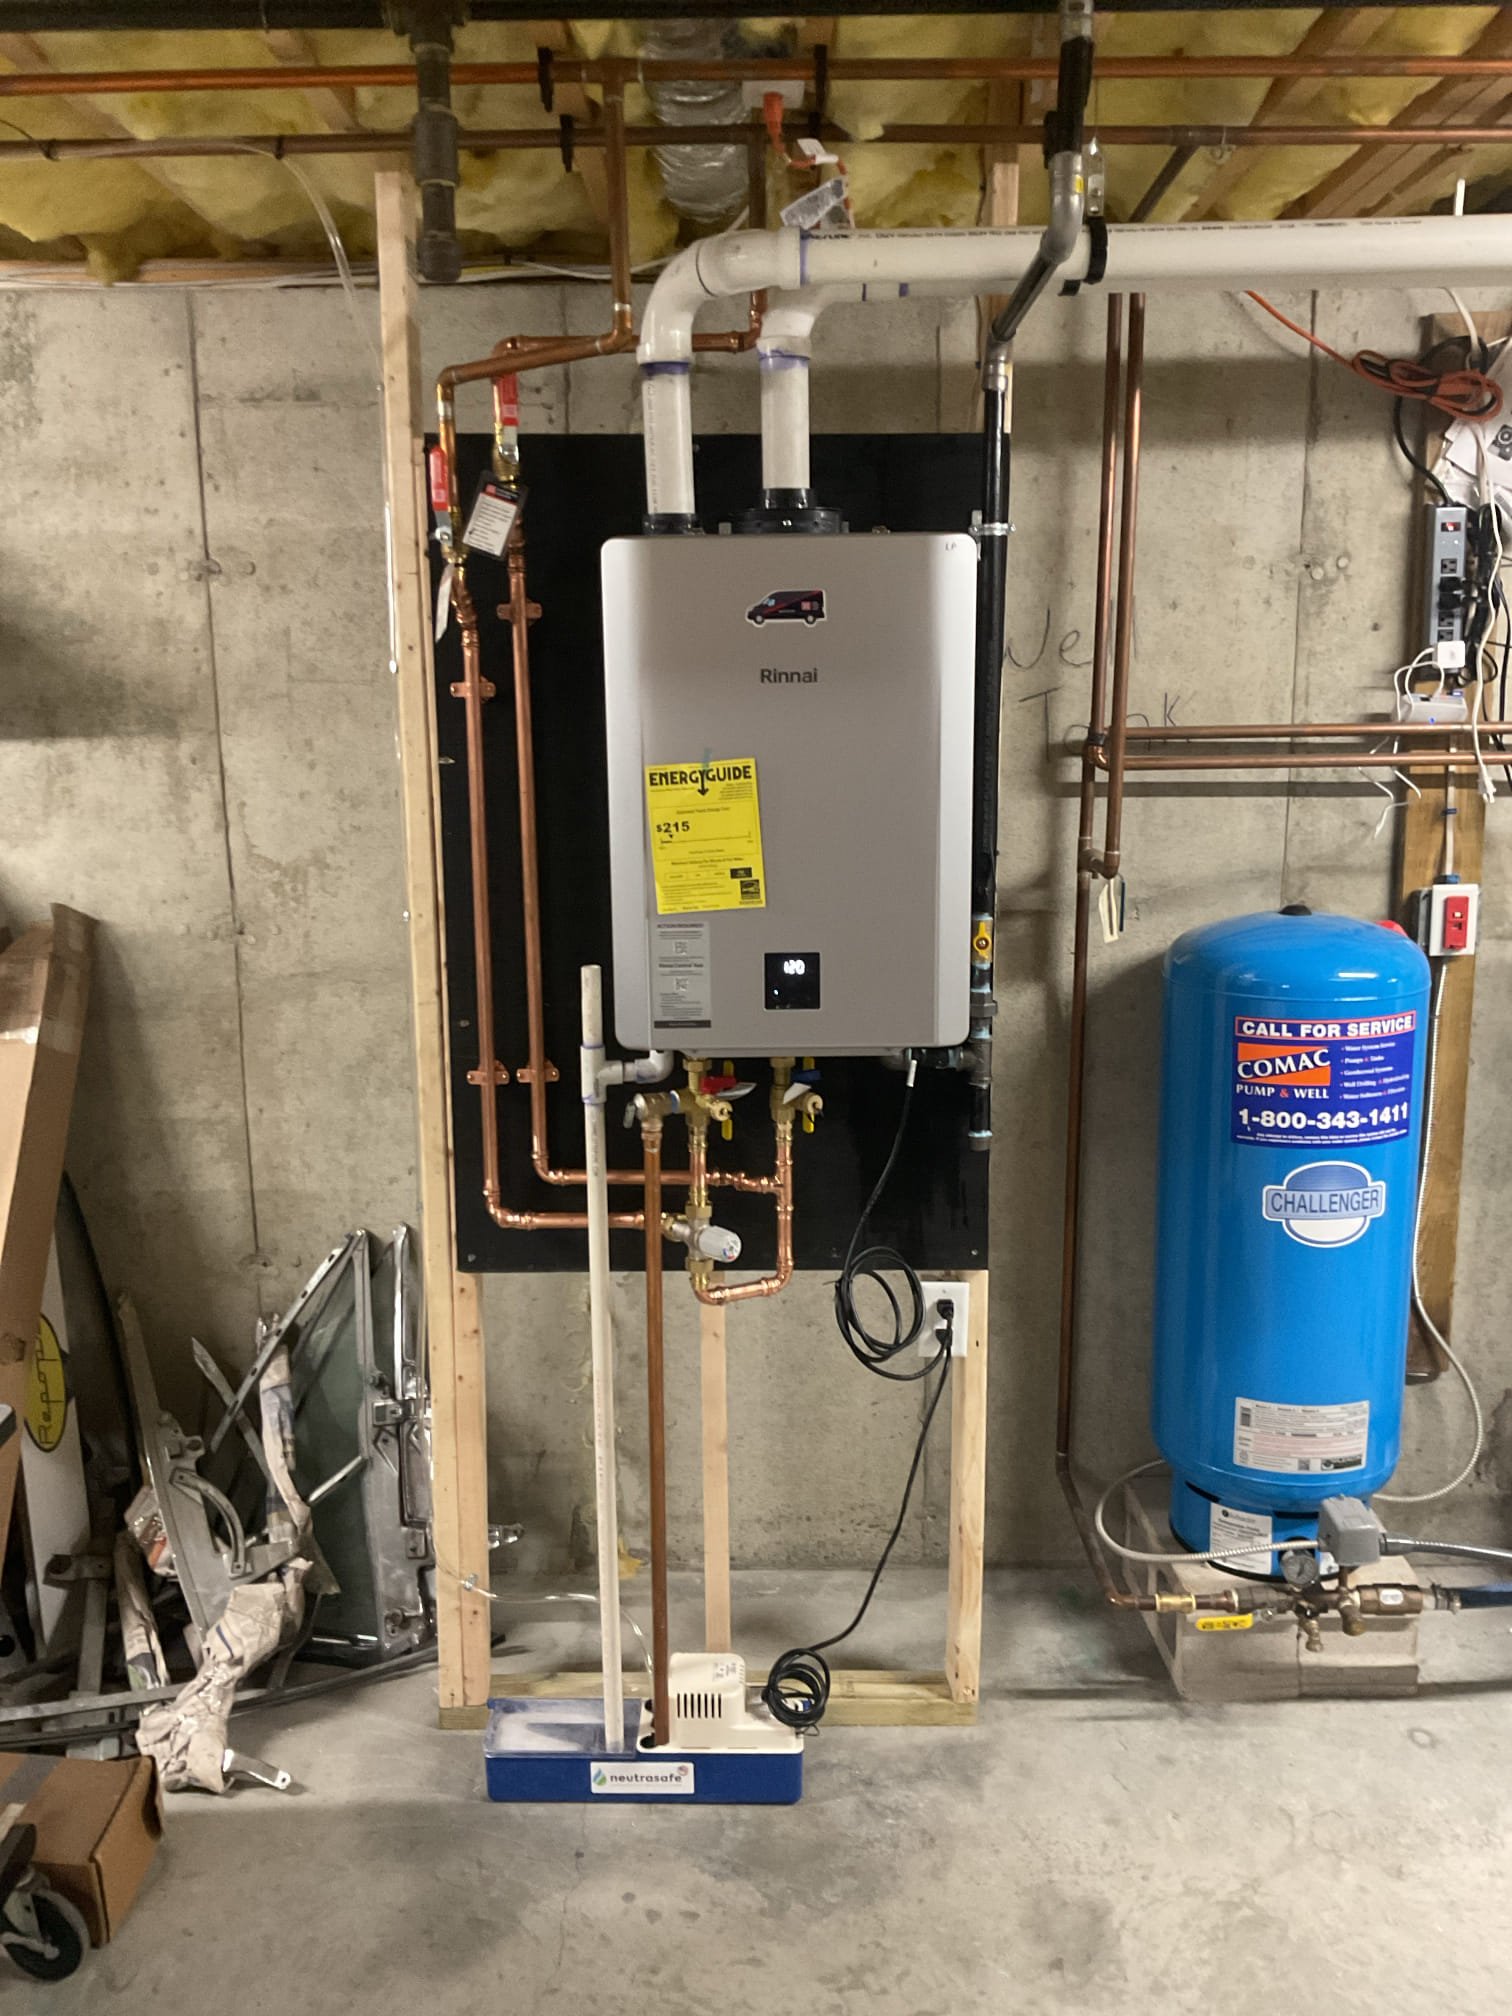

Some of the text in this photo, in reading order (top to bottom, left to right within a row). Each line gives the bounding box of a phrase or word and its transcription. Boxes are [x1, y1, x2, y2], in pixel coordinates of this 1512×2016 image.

[760, 668, 818, 684] Rinnai
[656, 820, 691, 834] $215
[1242, 1015, 1412, 1037] CALL FOR SERVICE
[1237, 1048, 1331, 1080] COMAC
[1236, 1084, 1329, 1099] PUMP & WELL
[1239, 1102, 1408, 1129] 1-800-343-1411
[1271, 1188, 1380, 1213] CHALLENGER
[610, 1772, 682, 1783] neutrasafe
